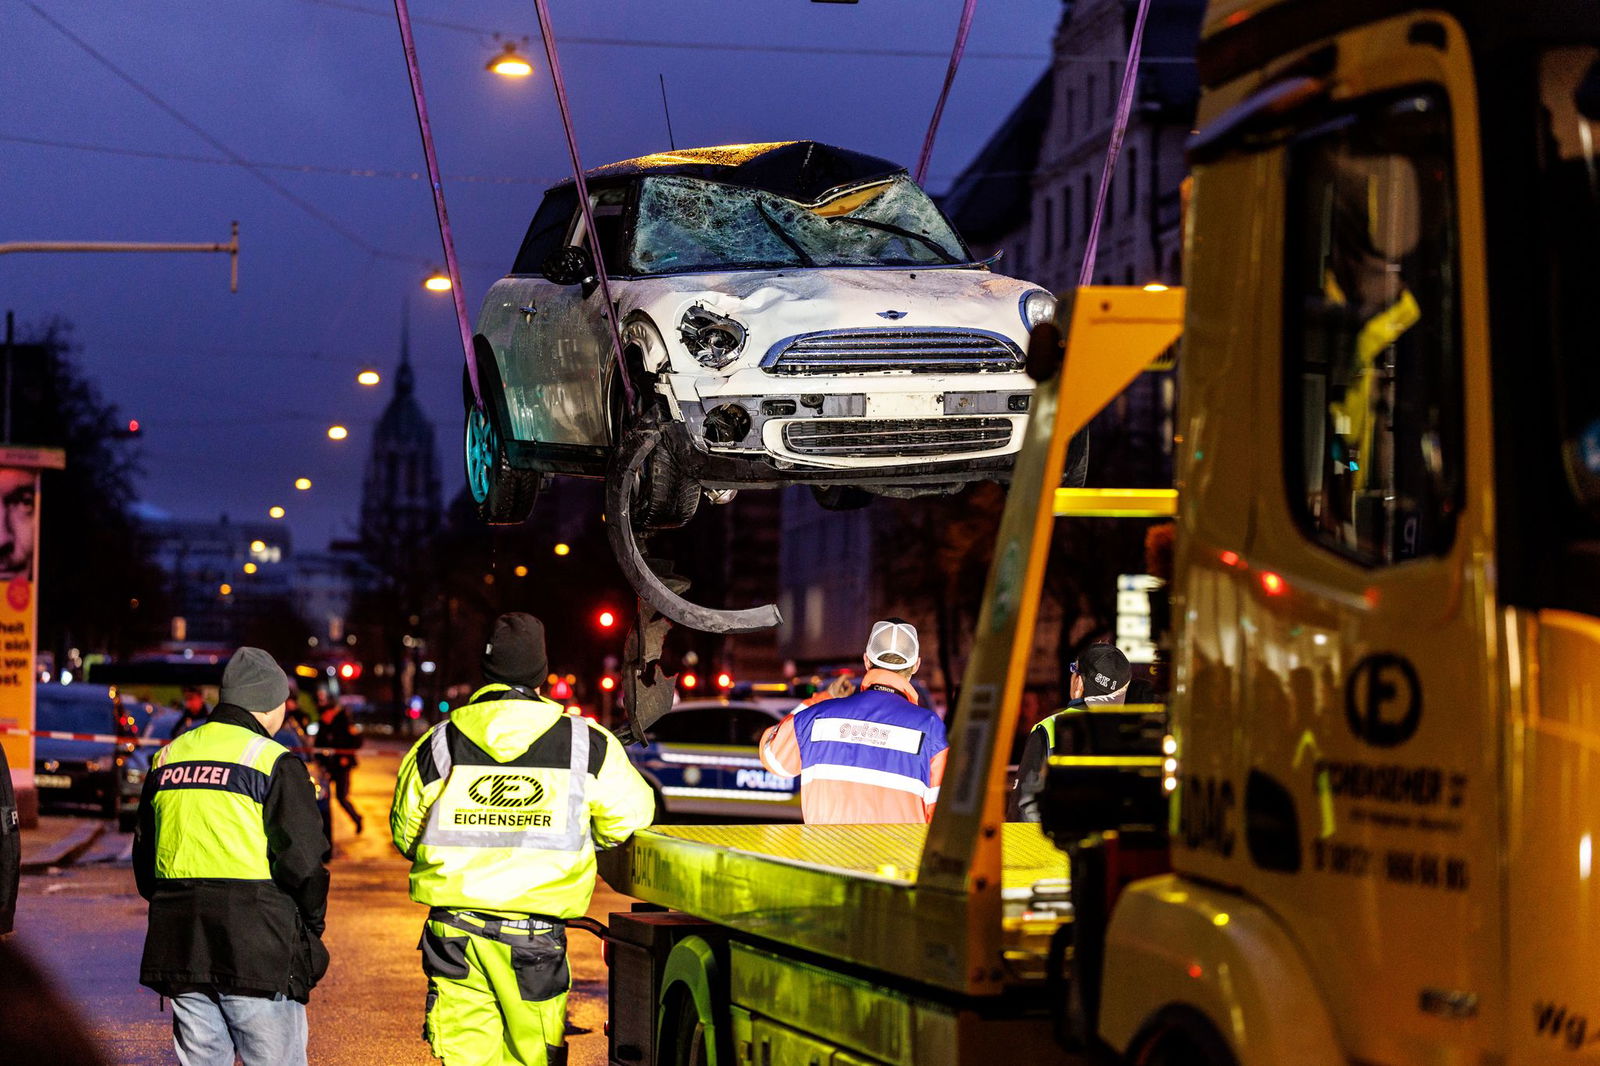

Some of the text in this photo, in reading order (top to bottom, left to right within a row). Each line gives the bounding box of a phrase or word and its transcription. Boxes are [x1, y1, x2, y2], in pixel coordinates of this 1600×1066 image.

[873, 685, 895, 694] Canon
[160, 765, 231, 786] POLIZEI
[736, 769, 794, 791] POLIZEI
[454, 813, 551, 827] EICHENSEHER
